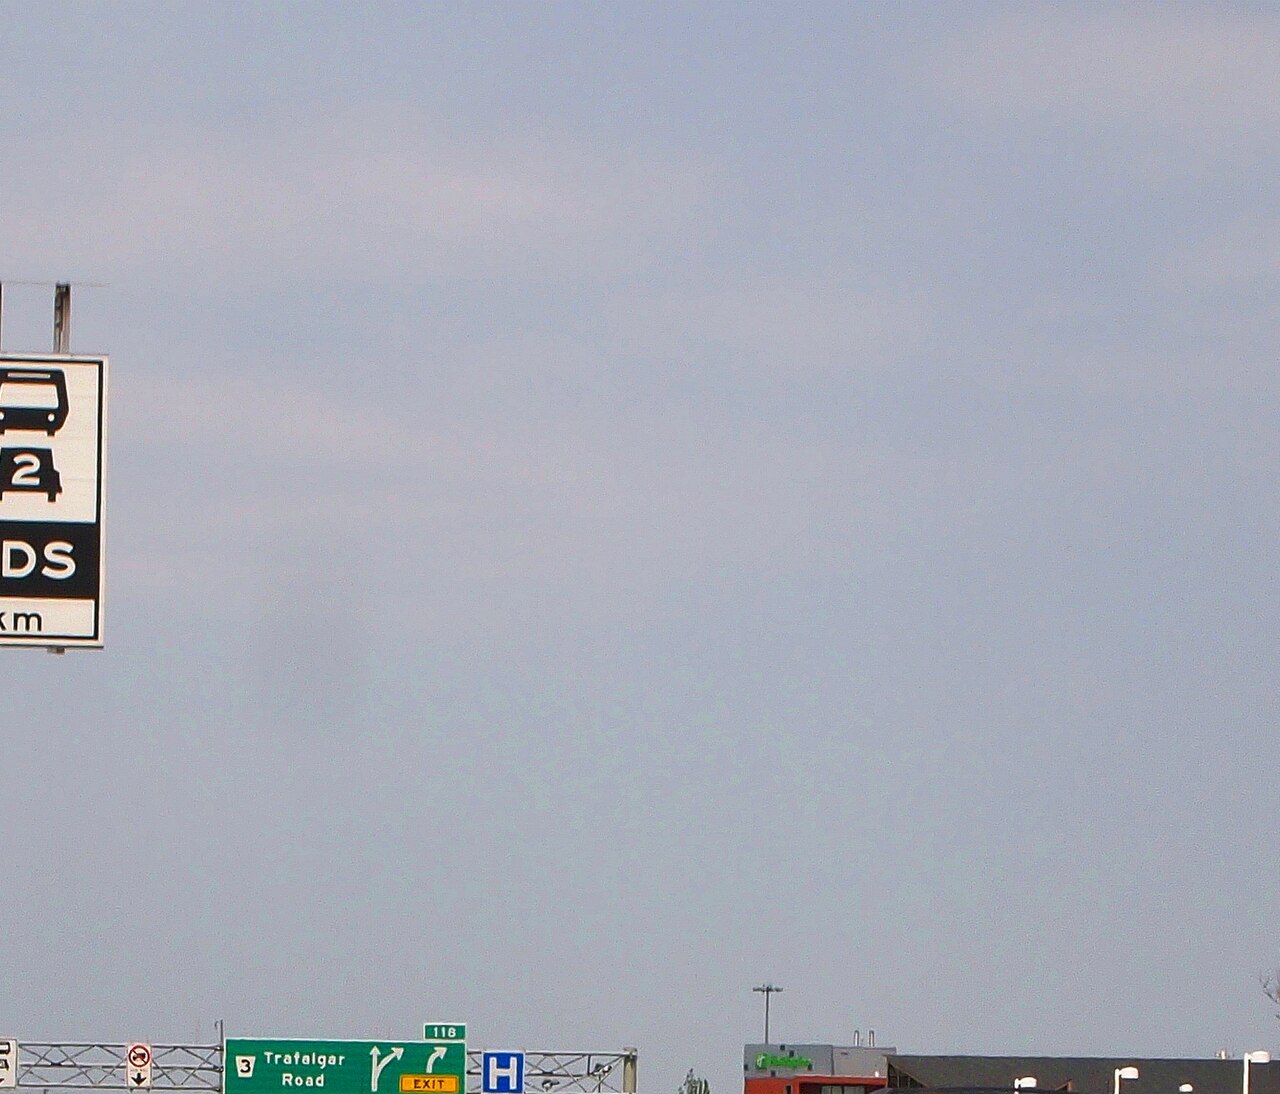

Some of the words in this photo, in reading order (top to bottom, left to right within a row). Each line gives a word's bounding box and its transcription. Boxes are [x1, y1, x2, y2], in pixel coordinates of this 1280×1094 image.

[11, 453, 40, 486] 2
[434, 1027, 456, 1038] 118
[240, 1059, 252, 1074] 3
[264, 1052, 346, 1069] Trafalgar
[282, 1073, 325, 1087] Road
[489, 1056, 518, 1090] H
[413, 1078, 446, 1091] EXIT
